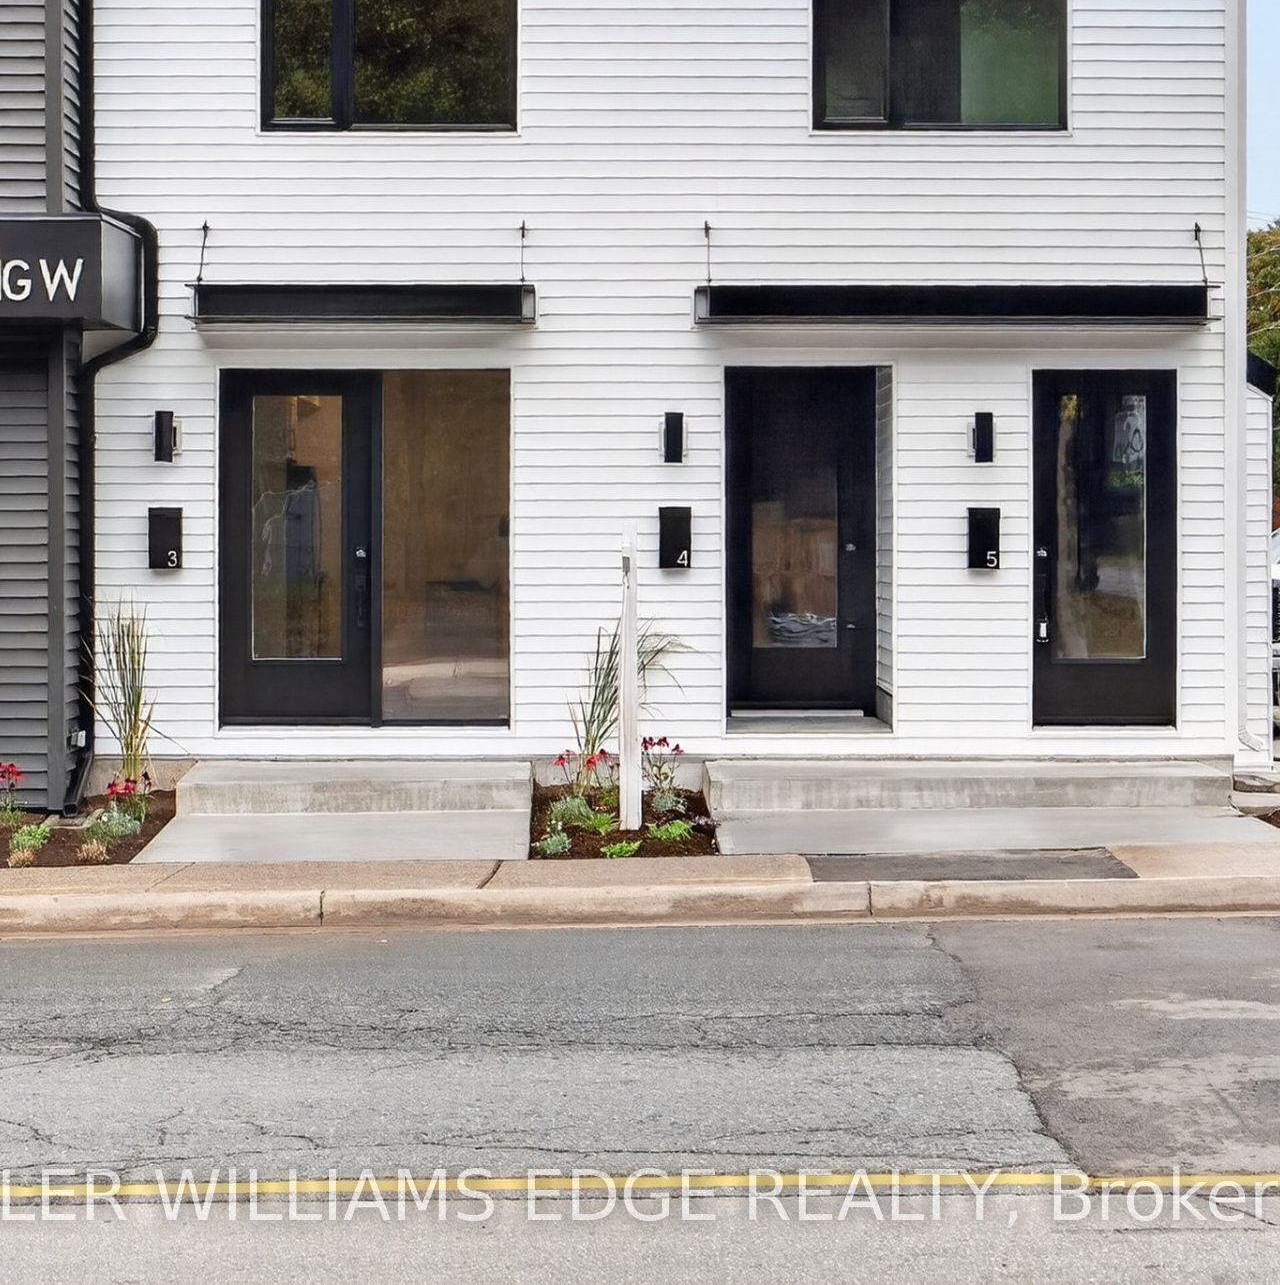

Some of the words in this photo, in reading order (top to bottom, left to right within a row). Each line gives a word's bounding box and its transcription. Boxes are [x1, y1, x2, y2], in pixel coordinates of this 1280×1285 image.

[39, 258, 84, 302] W
[167, 550, 178, 567] 3
[676, 549, 688, 567] 4
[986, 550, 998, 567] 5
